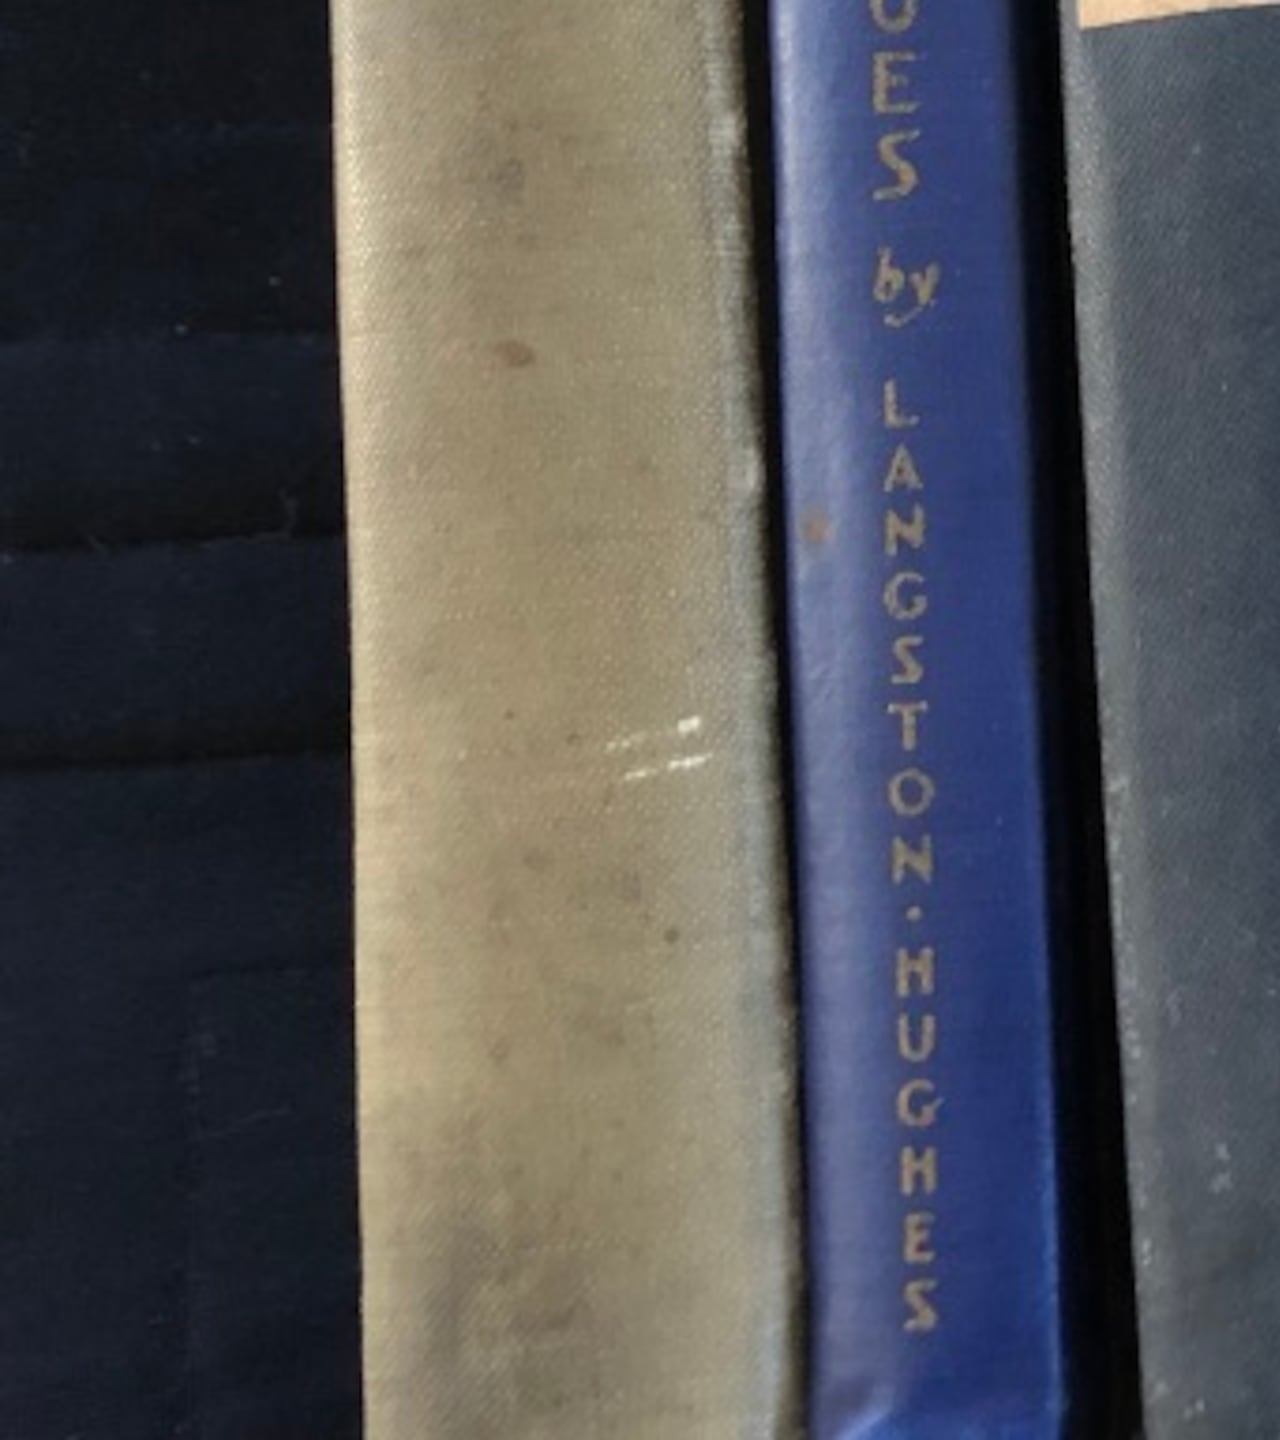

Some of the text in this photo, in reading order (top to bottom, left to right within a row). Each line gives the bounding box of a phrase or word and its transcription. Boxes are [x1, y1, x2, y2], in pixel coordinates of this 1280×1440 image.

[874, 248, 940, 327] by
[883, 380, 937, 883] LANGSTON
[897, 949, 942, 1333] HUGHES
